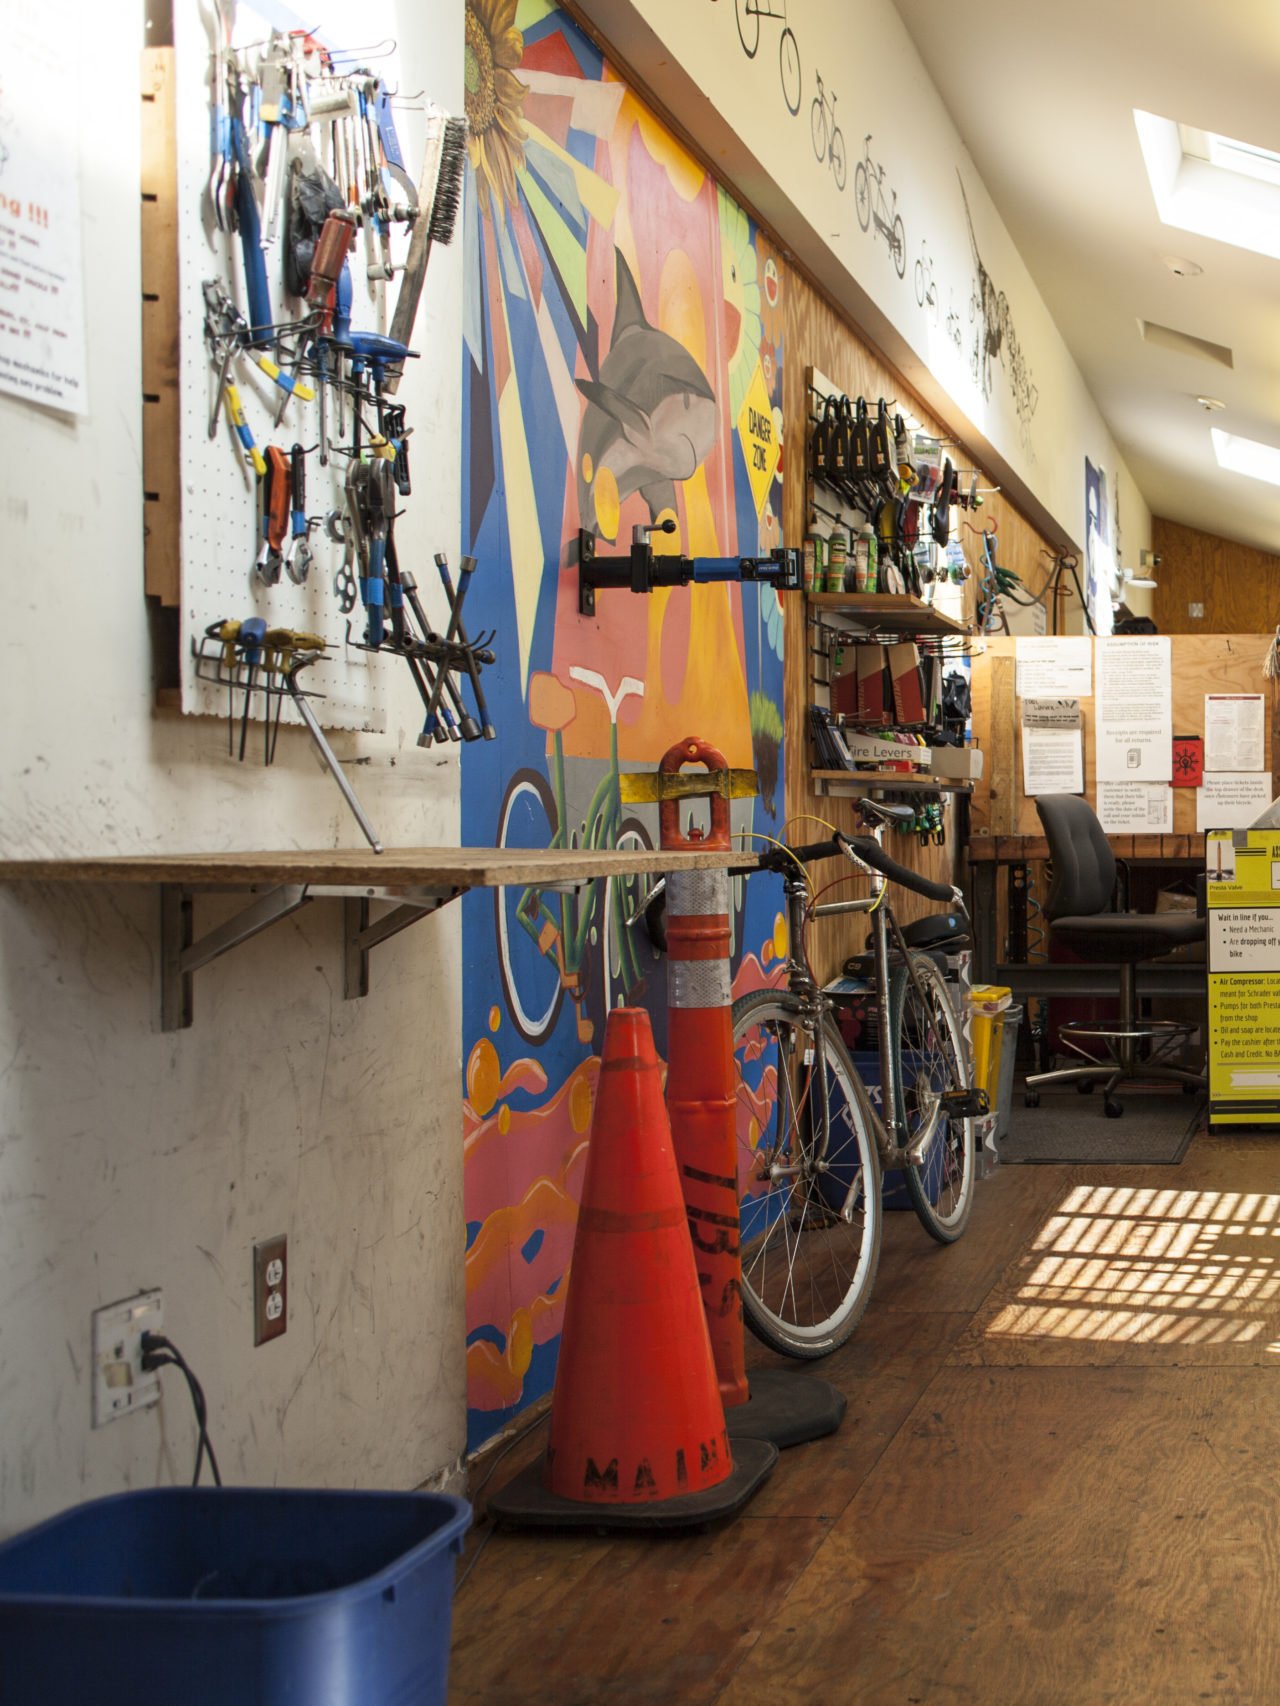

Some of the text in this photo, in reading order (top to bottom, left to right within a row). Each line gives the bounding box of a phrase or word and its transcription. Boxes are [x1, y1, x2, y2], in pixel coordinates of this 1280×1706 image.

[749, 406, 771, 444] DANGER
[752, 443, 767, 472] ZONE
[873, 745, 912, 758] Levers
[1218, 914, 1232, 922] Wait
[1252, 914, 1257, 922] if
[1249, 925, 1274, 933] Mechanic
[1240, 938, 1267, 947] dropping
[1268, 937, 1277, 946] off
[1230, 950, 1243, 958] bike
[1238, 990, 1246, 999] for
[1220, 1002, 1239, 1011] Pumps
[1240, 1002, 1249, 1011] for
[1220, 1014, 1258, 1023] from the shop
[1221, 1039, 1231, 1048] Pay
[1241, 1038, 1262, 1046] cashier
[1263, 1038, 1275, 1047] after
